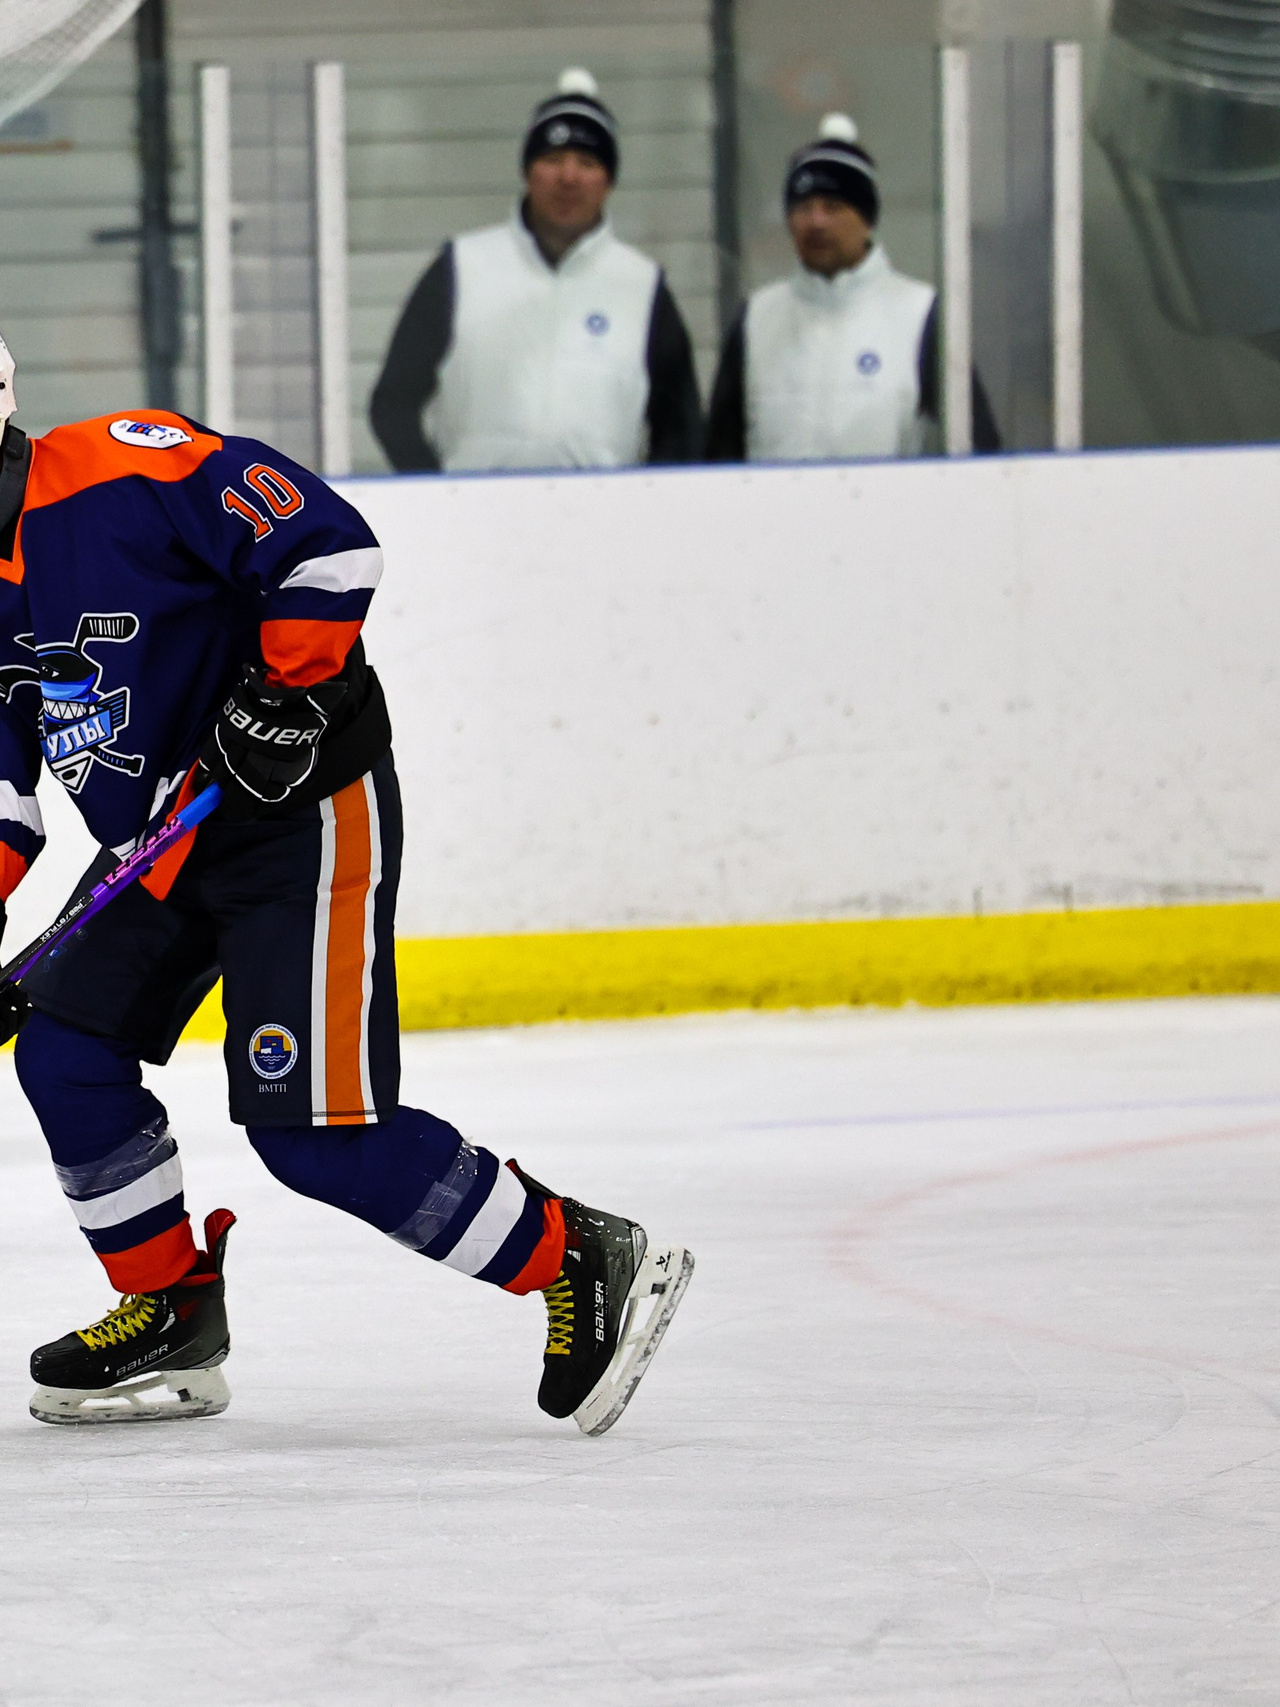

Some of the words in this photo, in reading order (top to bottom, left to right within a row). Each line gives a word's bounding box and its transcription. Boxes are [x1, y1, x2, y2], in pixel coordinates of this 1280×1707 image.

[221, 463, 304, 543] 10
[46, 716, 107, 759] УЛЫ
[222, 697, 320, 746] BAUER
[116, 1343, 169, 1378] BAUER
